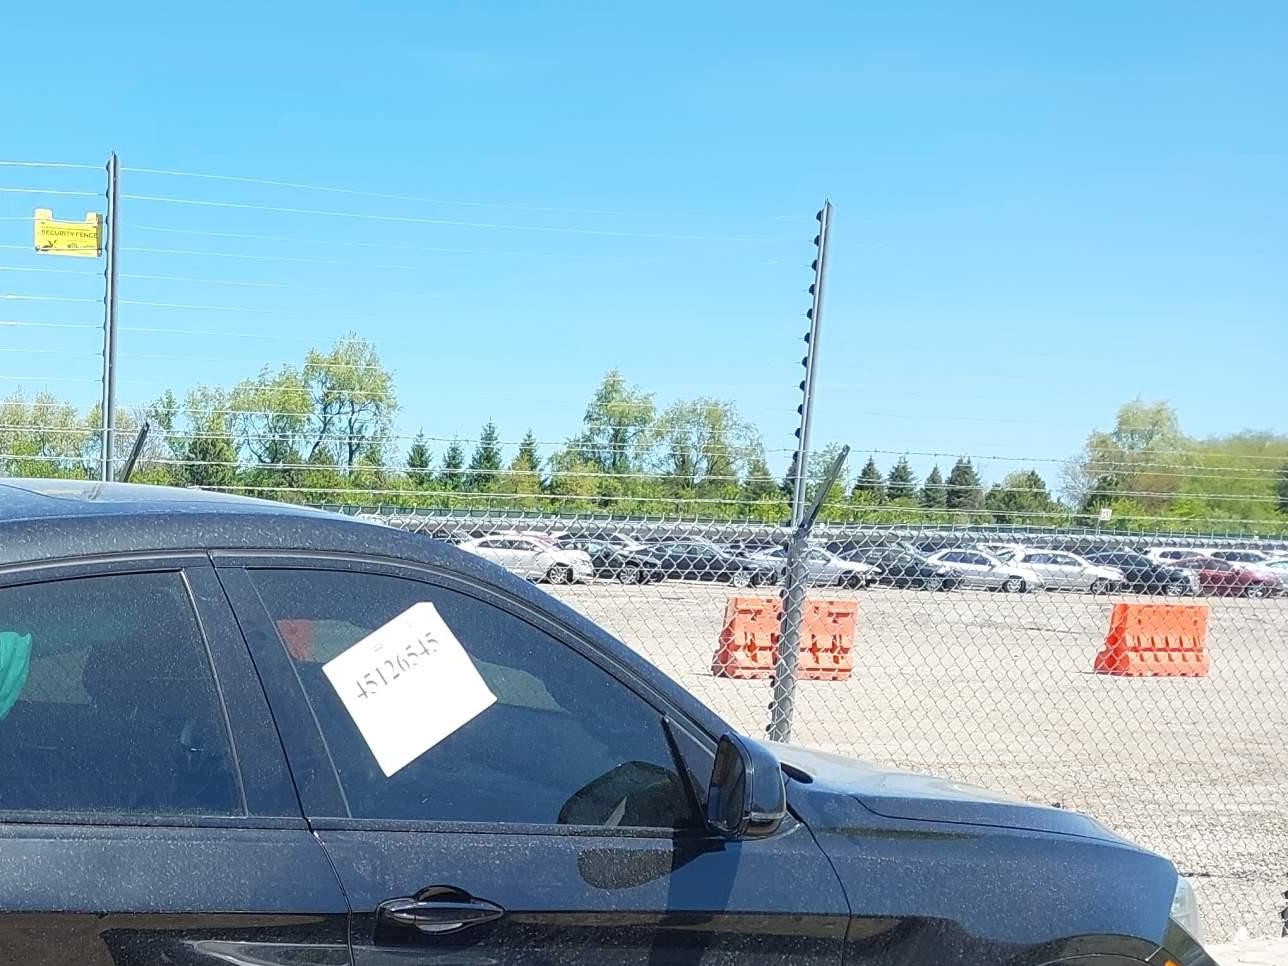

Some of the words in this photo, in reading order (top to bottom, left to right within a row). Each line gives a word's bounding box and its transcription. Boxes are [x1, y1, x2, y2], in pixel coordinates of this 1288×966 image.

[41, 229, 75, 238] SECURITY
[76, 231, 98, 239] FENCE
[356, 631, 440, 699] 45126545
